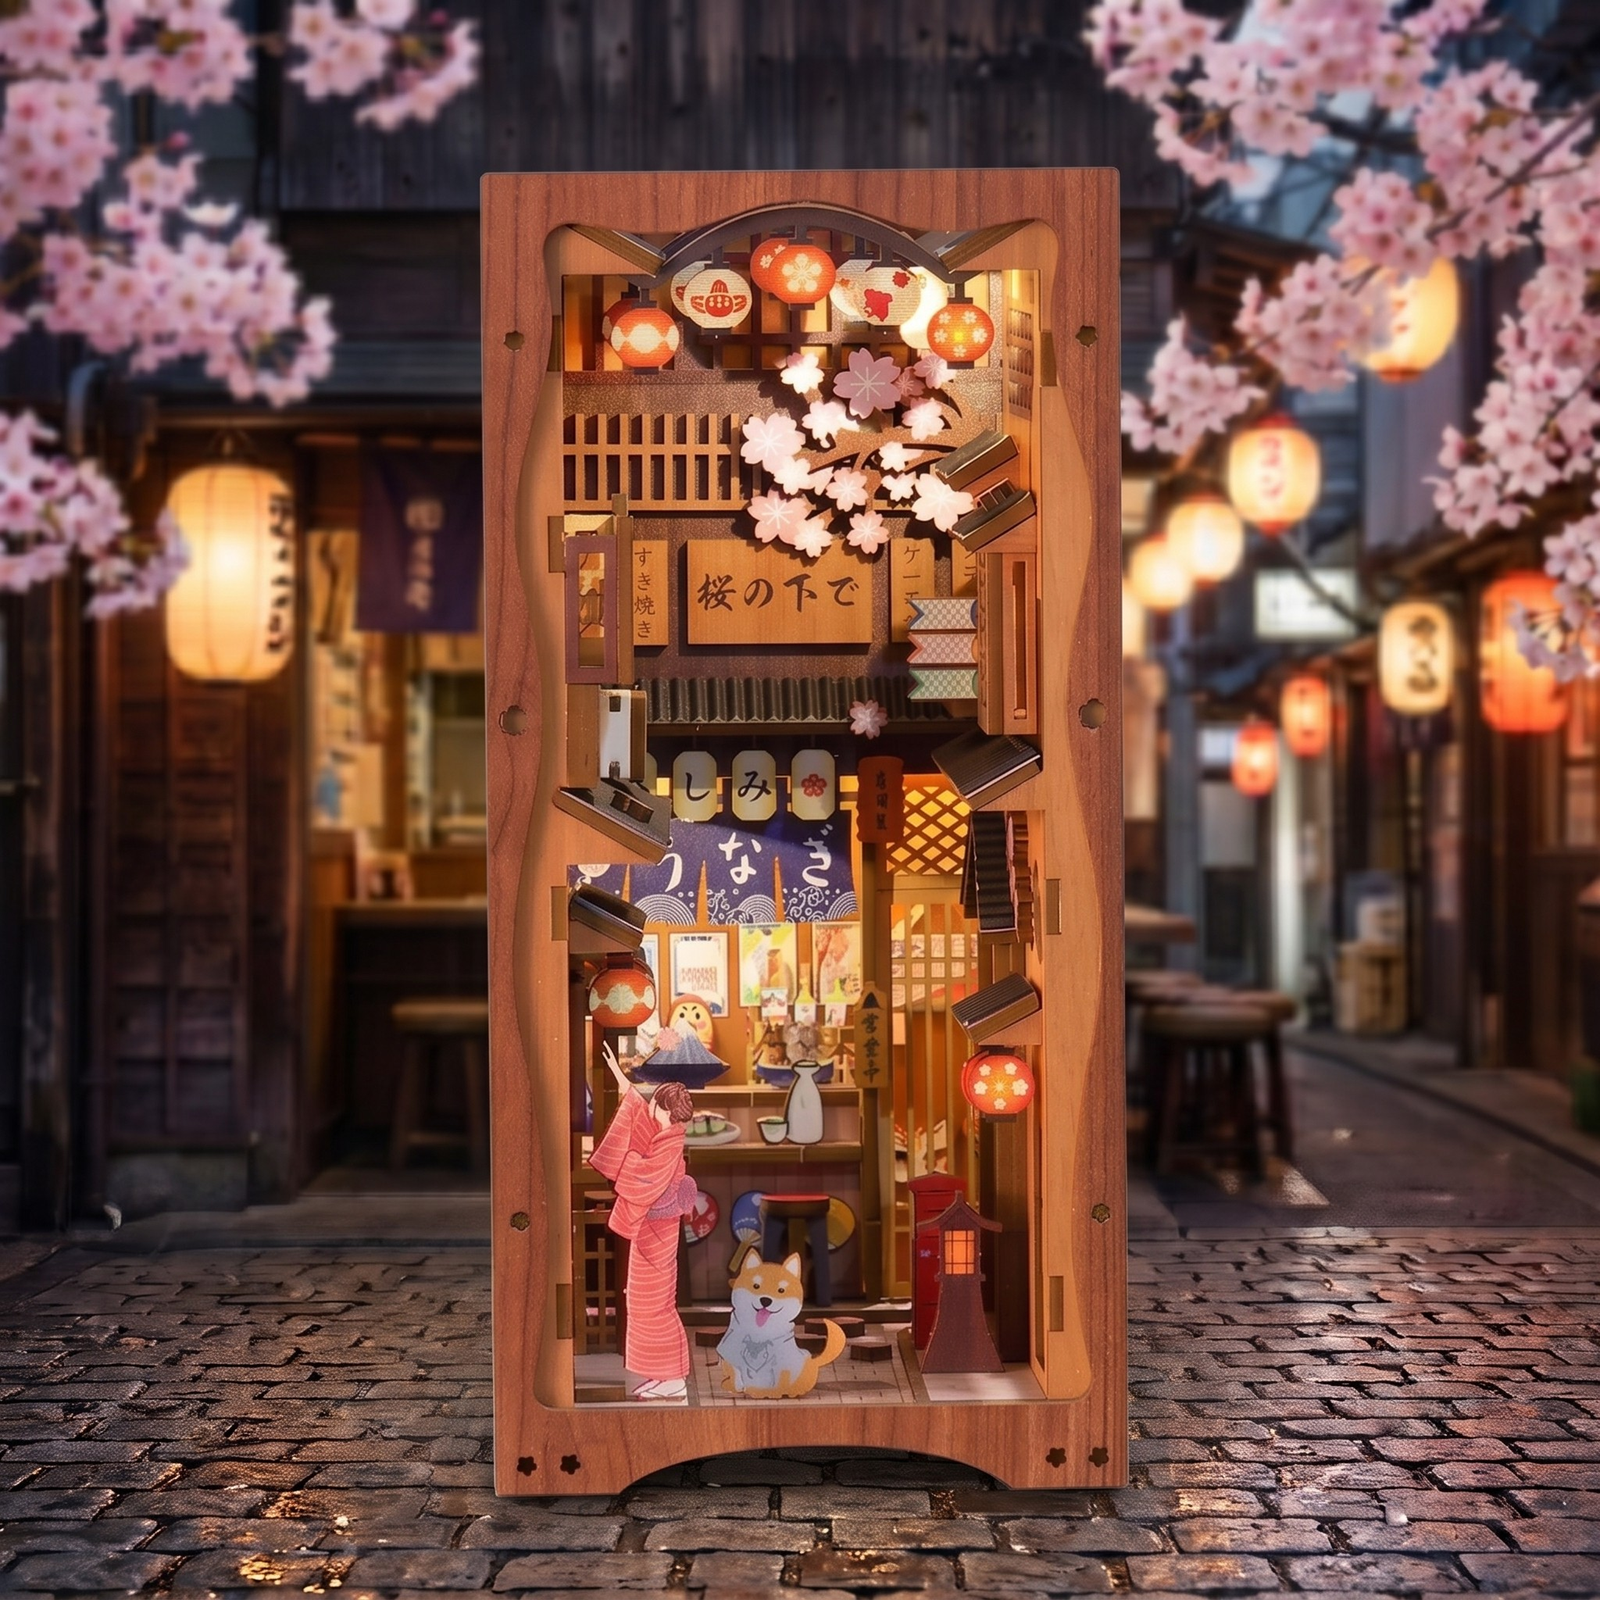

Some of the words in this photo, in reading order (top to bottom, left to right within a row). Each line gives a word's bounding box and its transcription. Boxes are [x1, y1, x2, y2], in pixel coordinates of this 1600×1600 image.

[633, 546, 656, 638] すき焼き
[696, 572, 860, 613] 桜の下で
